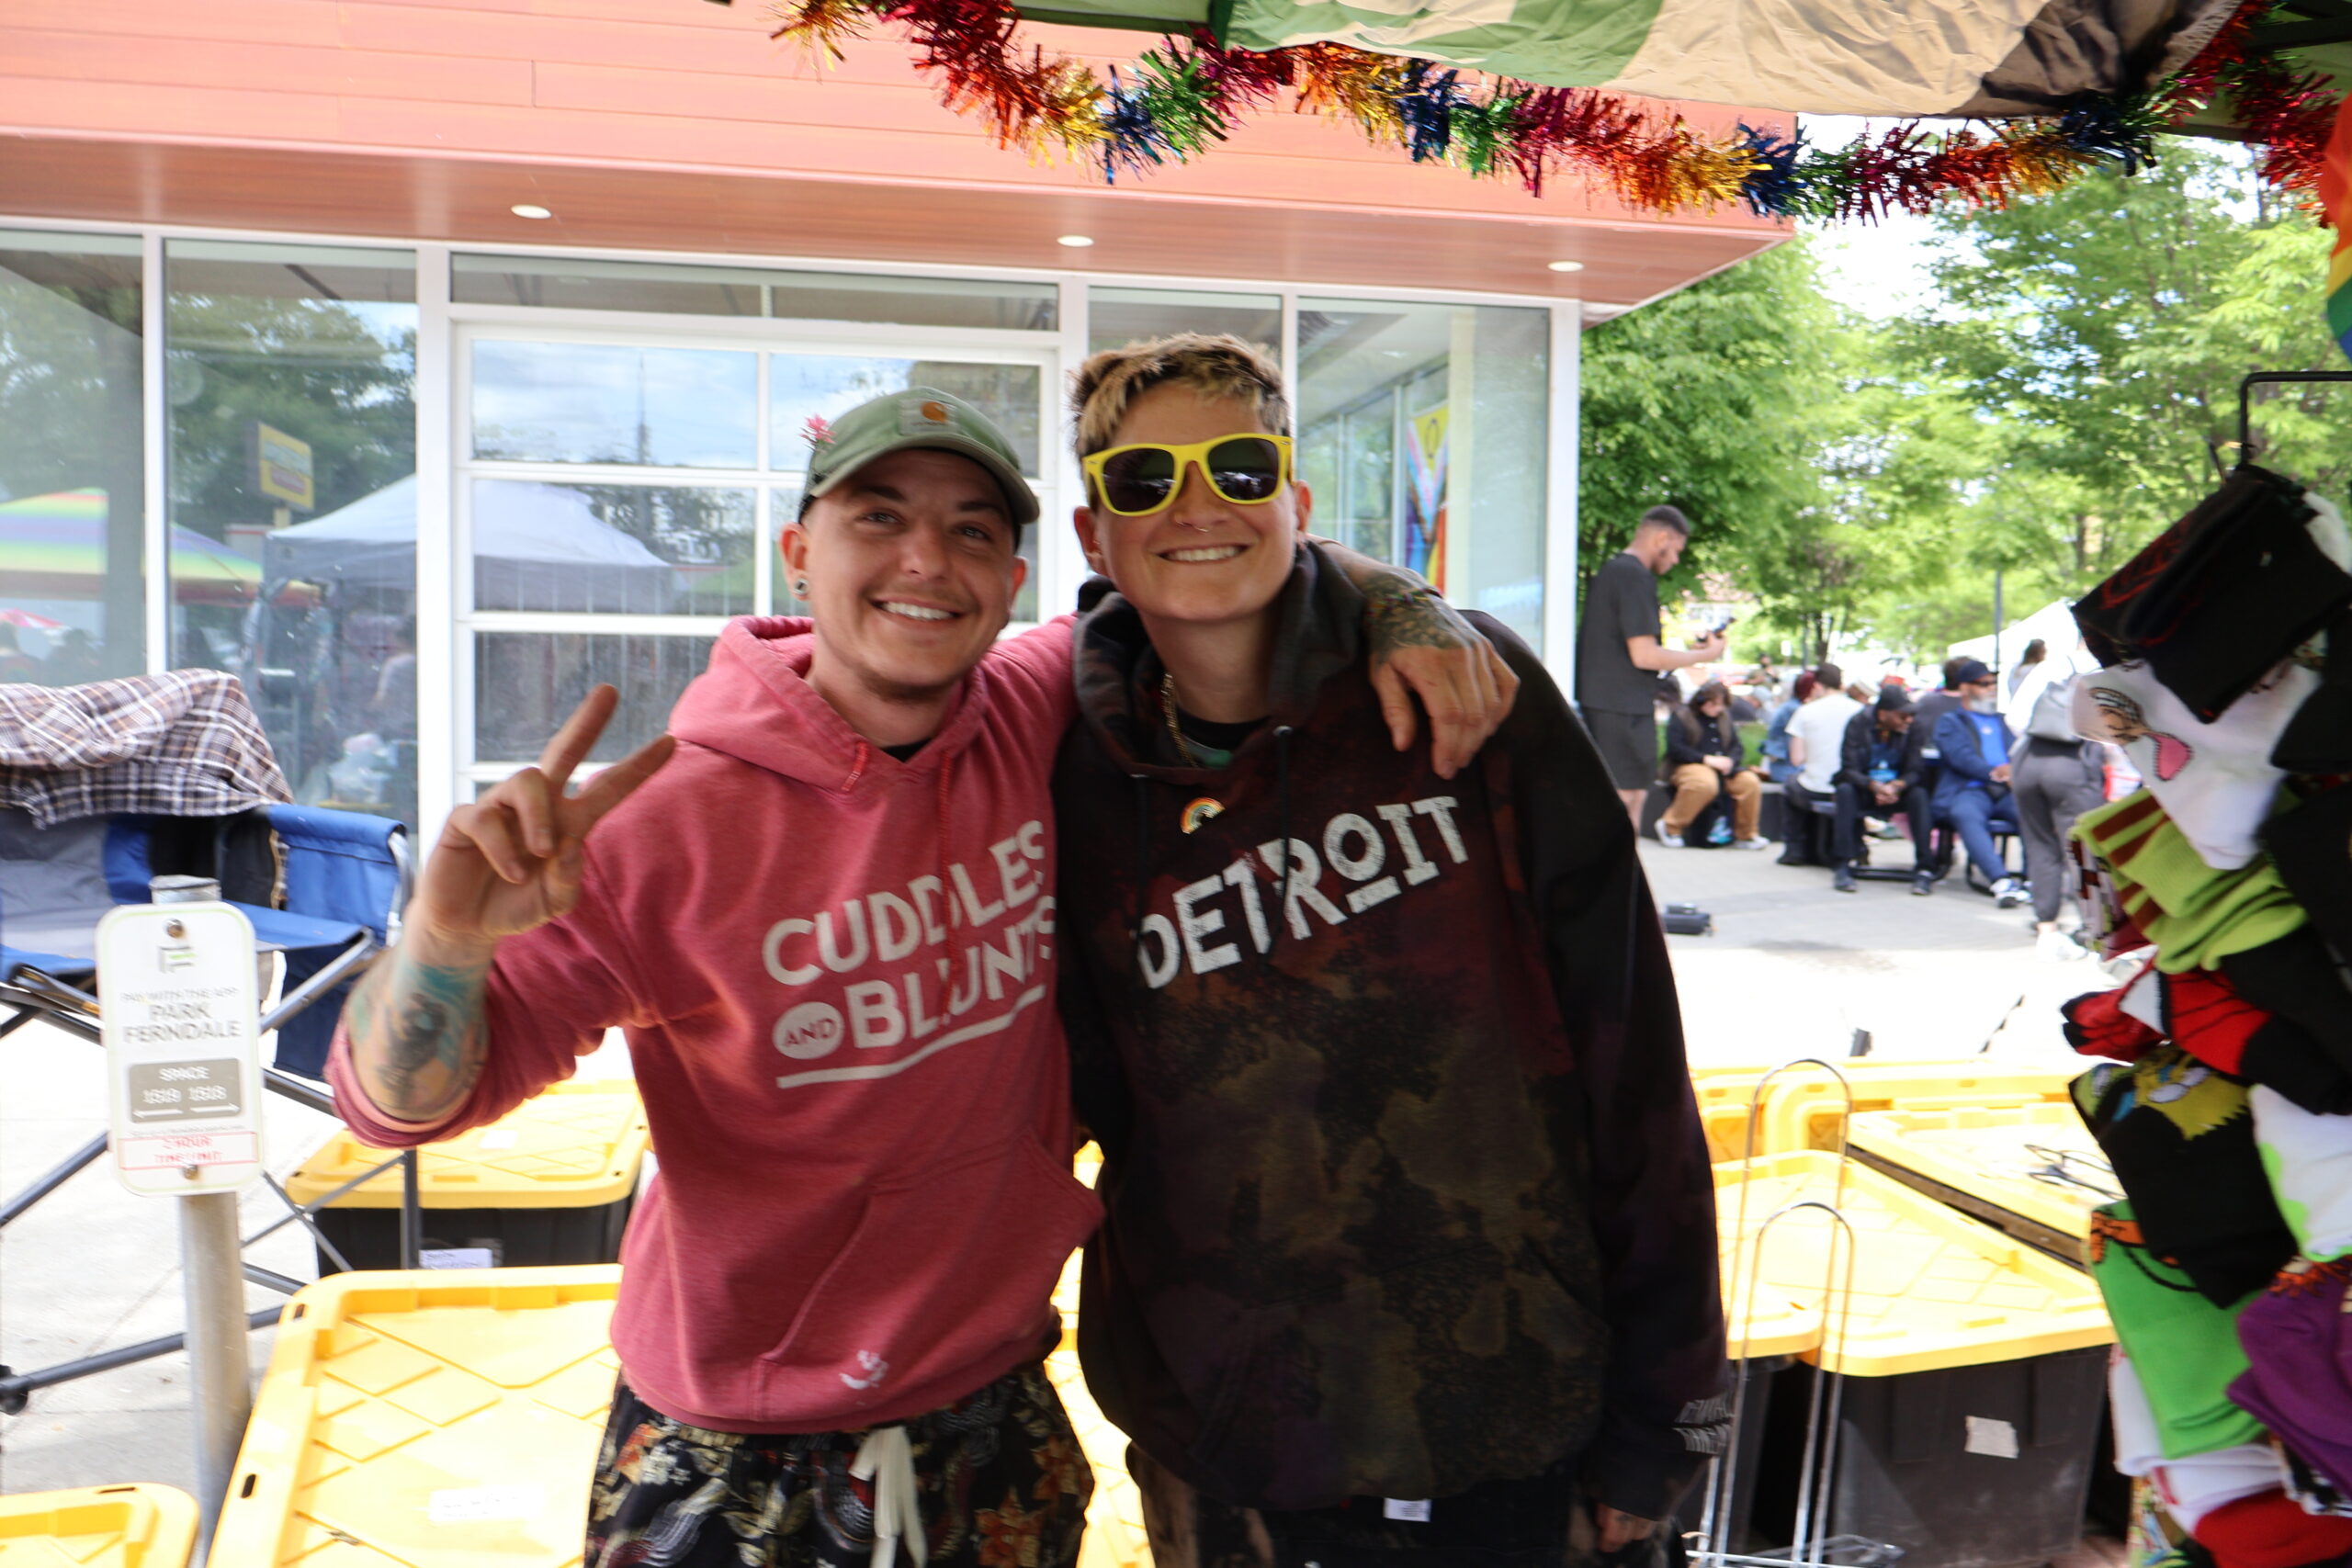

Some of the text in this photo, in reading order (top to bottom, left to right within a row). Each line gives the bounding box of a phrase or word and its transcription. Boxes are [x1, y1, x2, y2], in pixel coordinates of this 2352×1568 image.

[1136, 795, 1469, 989] DETROIT
[150, 1002, 212, 1021] PARK
[122, 1020, 242, 1043] FERNDALE
[784, 1016, 838, 1048] AND
[158, 1066, 210, 1081] SPACE
